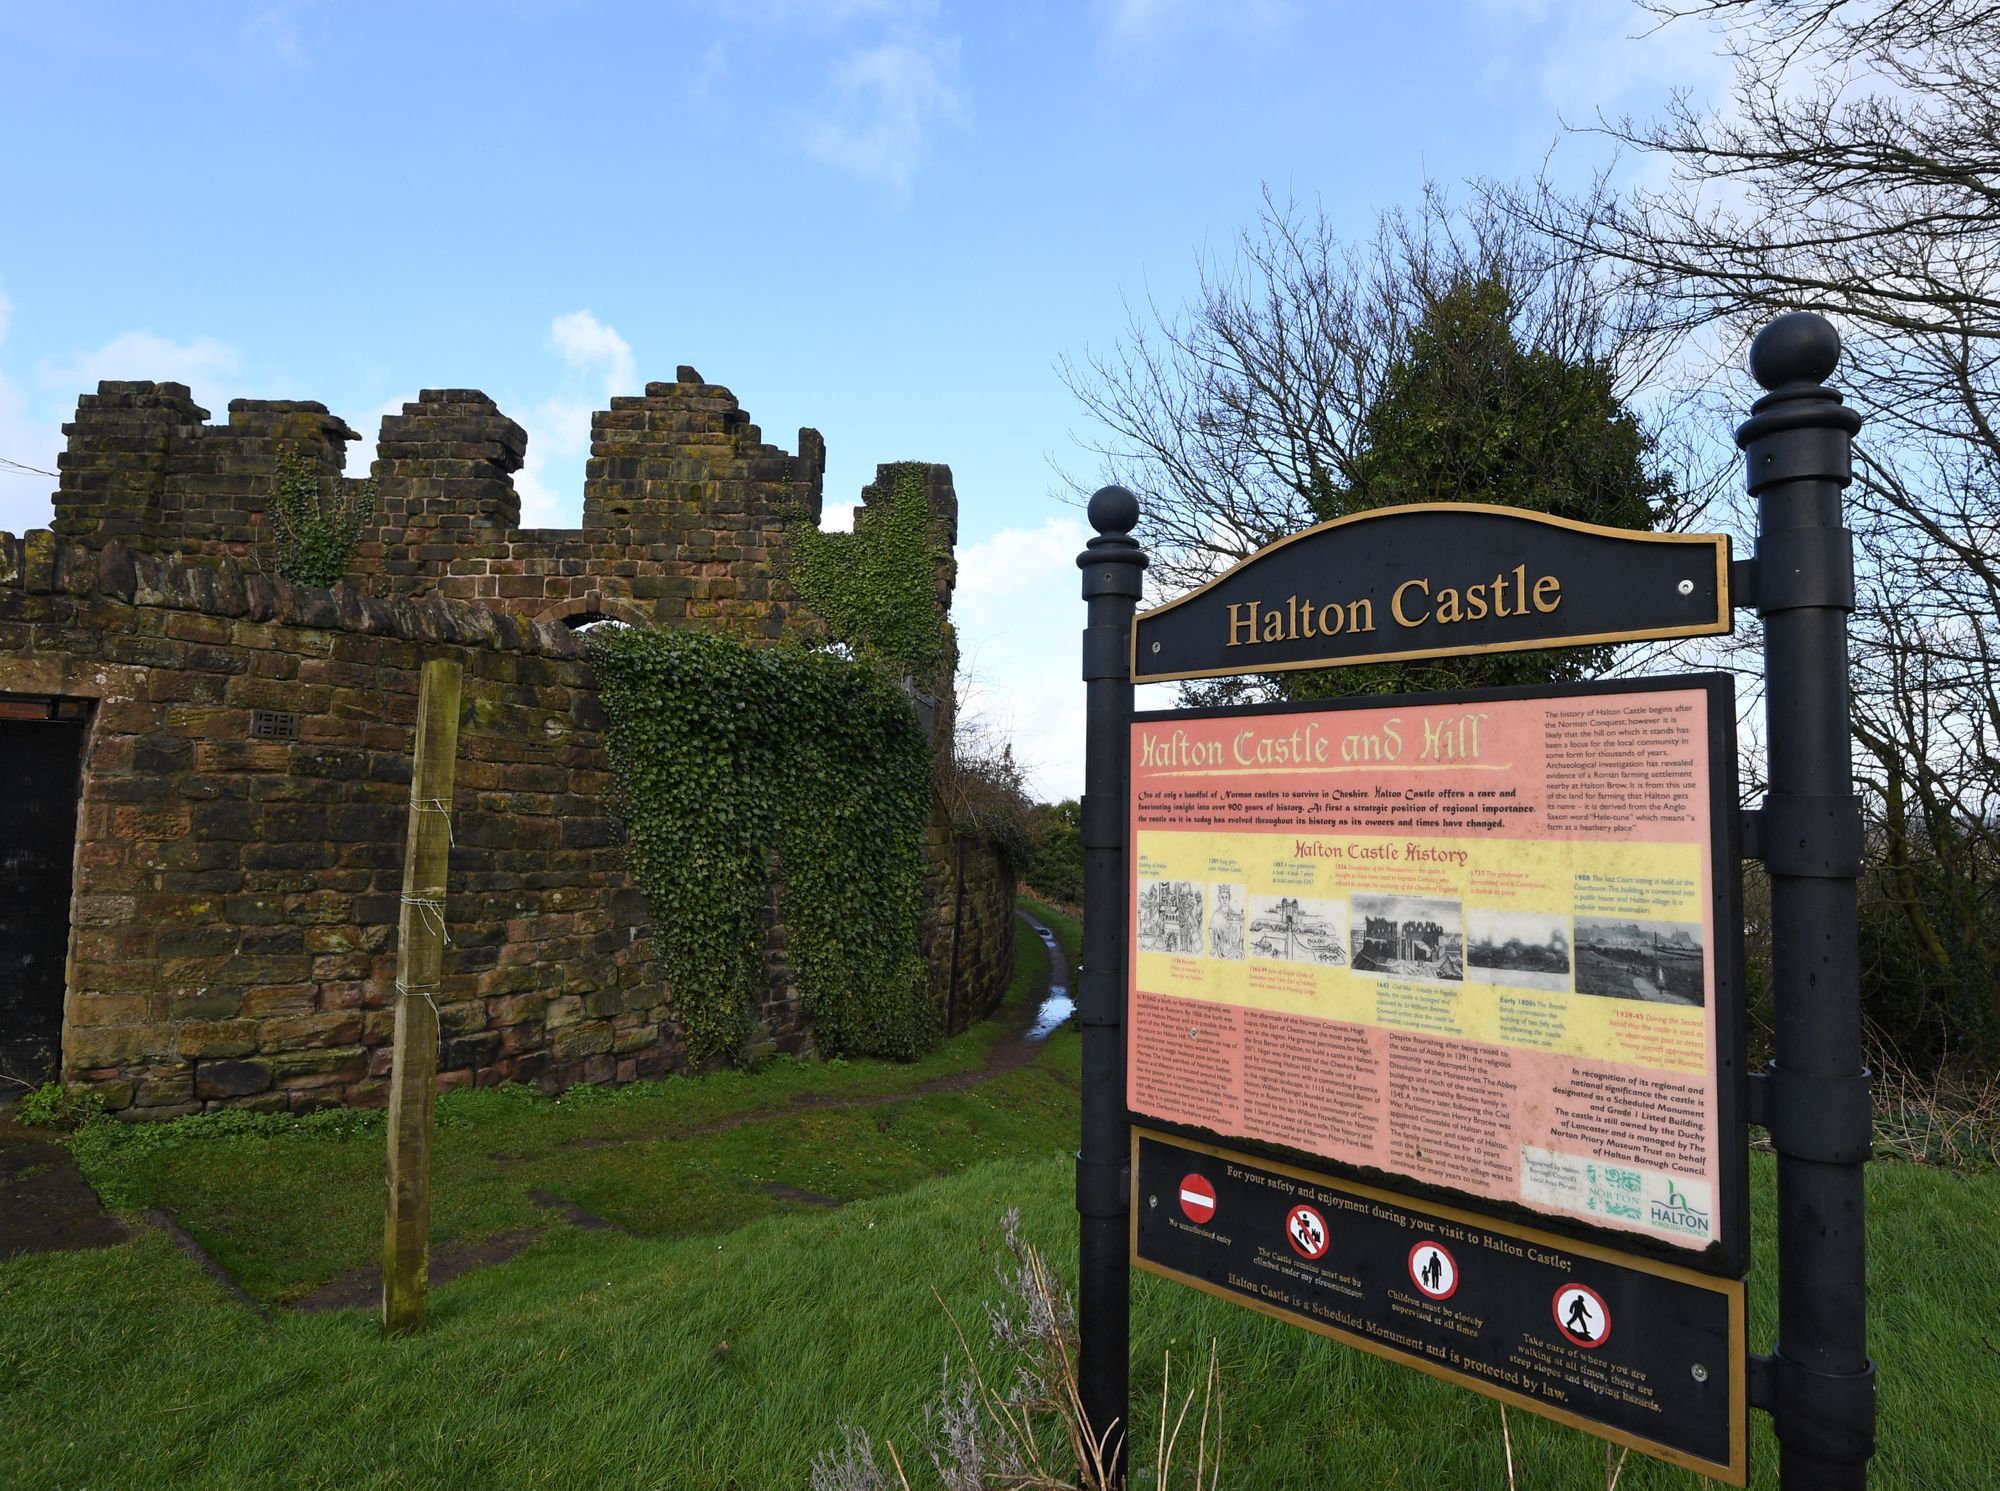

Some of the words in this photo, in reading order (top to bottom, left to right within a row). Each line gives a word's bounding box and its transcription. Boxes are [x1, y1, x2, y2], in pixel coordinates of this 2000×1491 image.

[1226, 597, 1376, 645] Halton
[1391, 566, 1561, 626] Castle
[1586, 708, 1595, 716] of
[1596, 708, 1621, 716] Halton
[1622, 706, 1647, 715] Castle
[1648, 705, 1673, 715] begins
[1674, 704, 1694, 712] after
[1139, 730, 1225, 767] Halton
[1232, 723, 1329, 766] Castle
[1340, 717, 1403, 761] and
[1420, 714, 1488, 758] Hill
[1545, 761, 1597, 770] Archaeological
[1598, 760, 1644, 769] investigation
[1660, 758, 1694, 767] revealed
[1577, 770, 1586, 779] of
[1593, 771, 1619, 779] Roman
[1620, 771, 1650, 780] farming
[1650, 770, 1693, 778] settlement
[1154, 791, 1162, 799] of
[1184, 790, 1209, 798] handful
[1210, 790, 1218, 799] of
[1219, 790, 1252, 801] Norman
[1254, 789, 1280, 798] castles
[1291, 789, 1319, 798] survive
[1321, 789, 1329, 798] in
[1374, 785, 1402, 798] Halton
[1404, 788, 1435, 801] Castle
[1437, 788, 1465, 798] offers
[1499, 787, 1516, 798] and
[1294, 840, 1344, 860] Halton
[1347, 842, 1399, 860] Castle
[1404, 842, 1468, 867] History
[1389, 1032, 1412, 1042] Despite
[1412, 1036, 1444, 1049] flourishing
[1444, 1041, 1460, 1050] after
[1461, 1043, 1479, 1055] being
[1479, 1047, 1499, 1056] raised
[1570, 1079, 1603, 1090] national
[1604, 1084, 1652, 1098] significance
[1654, 1089, 1668, 1101] the
[1670, 1096, 1695, 1105] castle
[1697, 1099, 1704, 1107] is
[1571, 1067, 1580, 1075] In
[1581, 1071, 1626, 1082] recognition
[1628, 1077, 1638, 1086] of
[1638, 1078, 1649, 1087] its
[1650, 1081, 1686, 1092] regional
[1687, 1087, 1704, 1095] and
[1552, 1086, 1594, 1099] designated
[1613, 1096, 1655, 1110] Scheduled
[1657, 1103, 1705, 1118] Monument
[1589, 1104, 1605, 1112] and
[1606, 1105, 1632, 1117] Grade
[1641, 1111, 1666, 1123] Listed
[1554, 1106, 1569, 1117] The
[1571, 1112, 1594, 1121] castle
[1595, 1115, 1602, 1123] is
[1603, 1117, 1618, 1125] still
[1619, 1121, 1647, 1131] owned
[1649, 1124, 1659, 1135] by
[1661, 1127, 1675, 1136] the
[1677, 1129, 1705, 1142] Duchy
[1560, 1119, 1570, 1129] of
[1570, 1121, 1610, 1134] Lancaster
[1610, 1130, 1627, 1138] and
[1628, 1132, 1635, 1140] is
[1636, 1133, 1676, 1147] managed
[1677, 1140, 1688, 1151] by
[1688, 1141, 1705, 1153] The
[1550, 1127, 1579, 1139] Norton
[1580, 1133, 1604, 1146] Priory
[1606, 1138, 1641, 1152] Museum
[1642, 1144, 1665, 1156] Trust
[1664, 1151, 1676, 1159] on
[1678, 1149, 1707, 1166] behalf
[1592, 1147, 1602, 1157] of
[1603, 1149, 1632, 1161] Halton
[1633, 1154, 1669, 1169] Borough
[1671, 1162, 1707, 1176] Council.
[1589, 1187, 1640, 1204] NORTON
[1227, 1165, 1243, 1178] For
[1244, 1172, 1265, 1185] your
[1267, 1178, 1295, 1195] safety
[1297, 1187, 1315, 1199] and
[1317, 1192, 1369, 1213] enjoyment
[1372, 1205, 1407, 1227] during
[1409, 1217, 1435, 1232] your
[1438, 1224, 1464, 1240] visit
[1467, 1232, 1479, 1244] to
[1483, 1235, 1524, 1257] Halton
[1651, 1207, 1708, 1231] HALTON
[1228, 1272, 1259, 1292] Halton
[1260, 1284, 1290, 1303] Castle
[1292, 1294, 1301, 1307] is
[1303, 1301, 1309, 1310] a
[1312, 1302, 1363, 1329] Scheduled
[1366, 1320, 1423, 1350] Monument
[1425, 1344, 1447, 1359] and
[1450, 1349, 1460, 1363] is
[1463, 1357, 1519, 1384] protected
[1522, 1374, 1538, 1393] by
[1542, 1382, 1569, 1402] law.
[1522, 1333, 1544, 1350] Take
[1546, 1343, 1565, 1354] care
[1567, 1349, 1578, 1358] of
[1579, 1353, 1608, 1368] where
[1610, 1363, 1629, 1375] you
[1631, 1370, 1646, 1381] are
